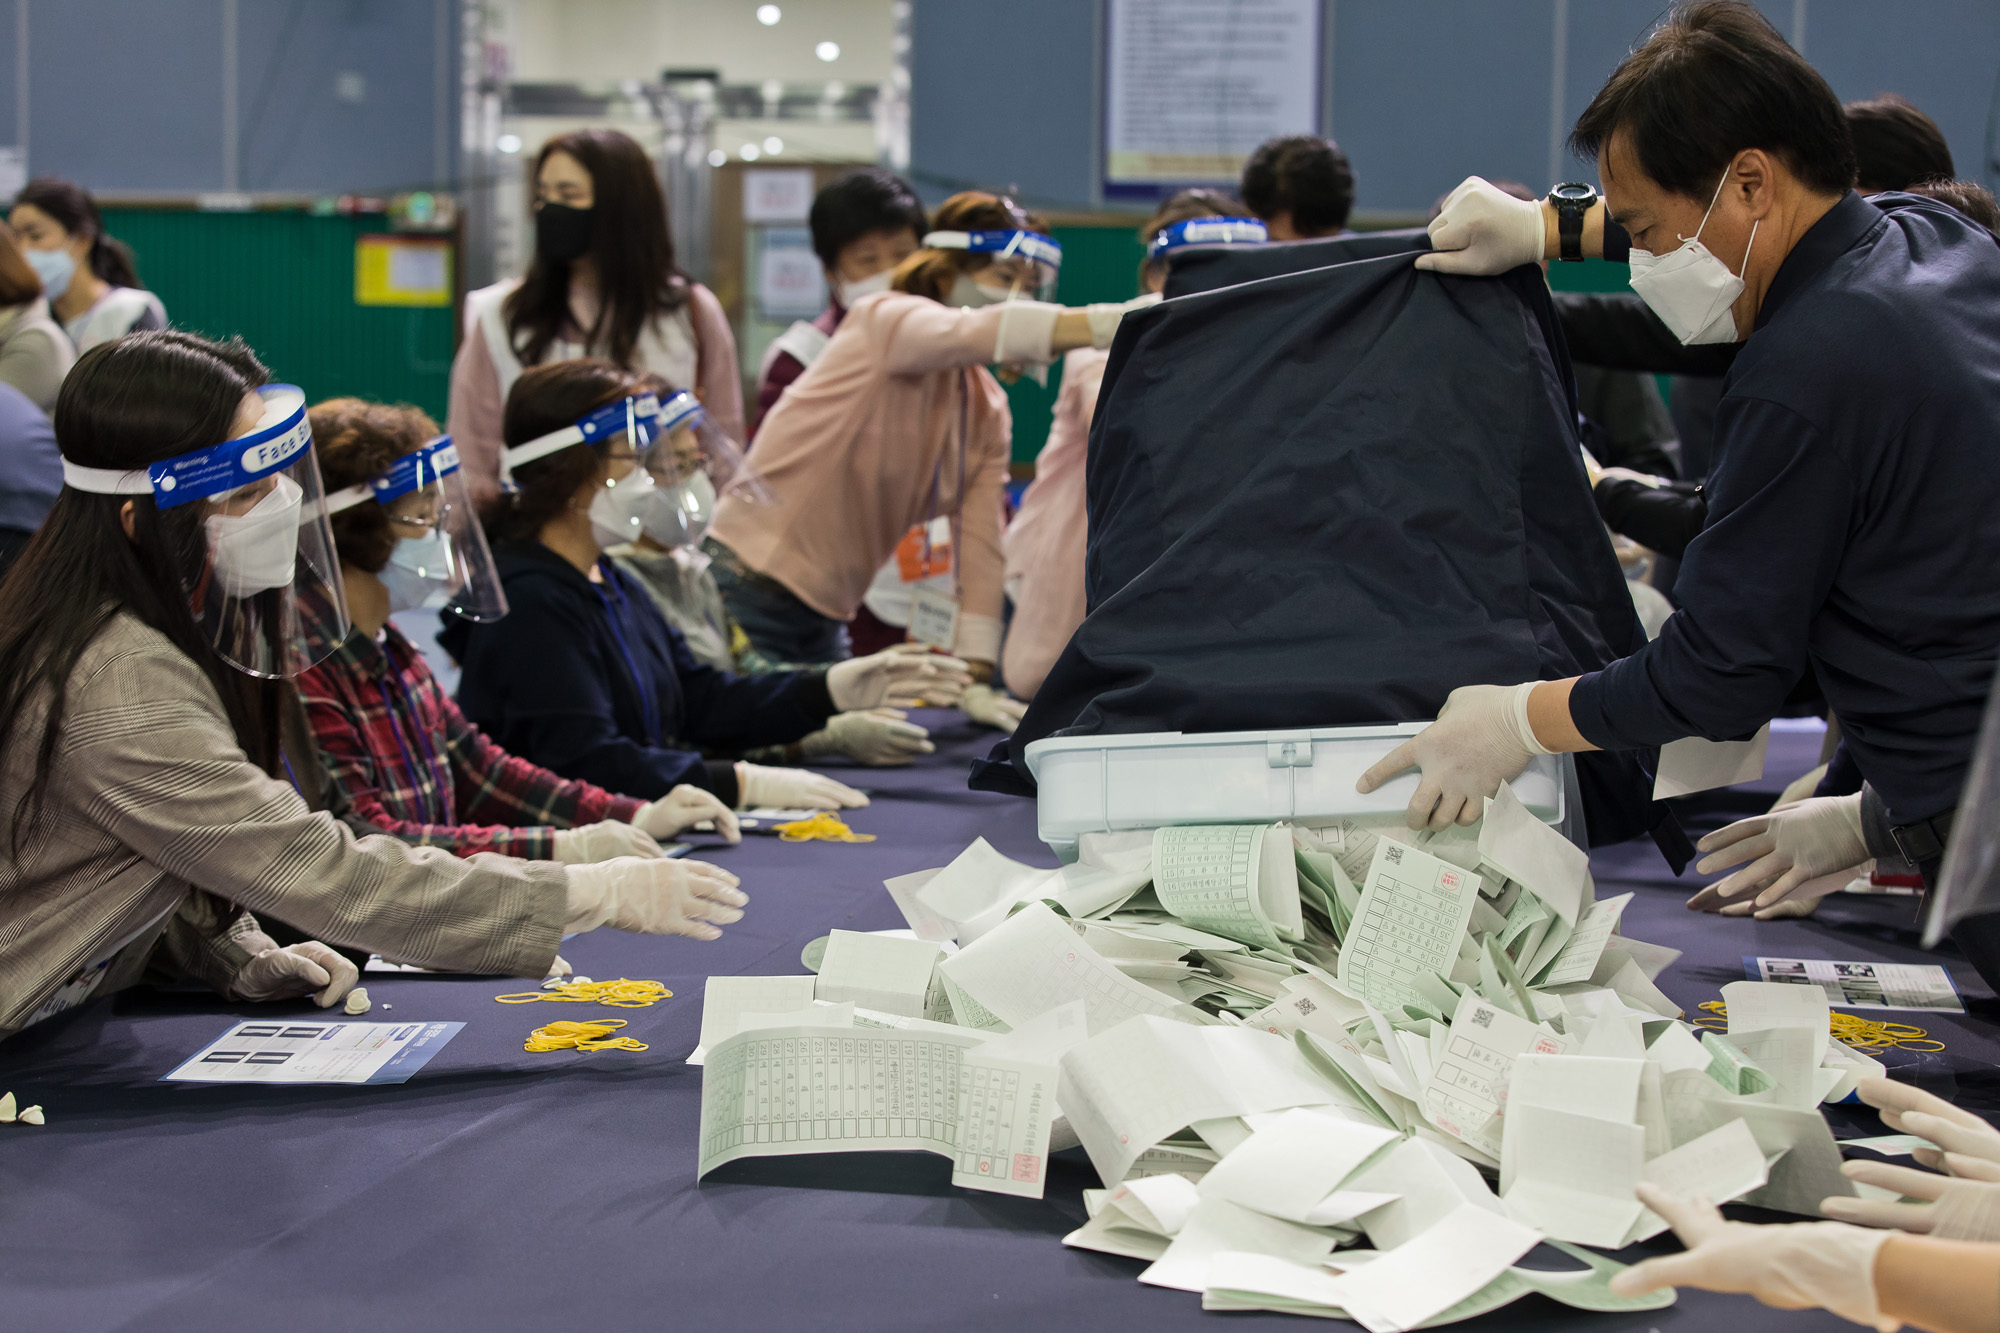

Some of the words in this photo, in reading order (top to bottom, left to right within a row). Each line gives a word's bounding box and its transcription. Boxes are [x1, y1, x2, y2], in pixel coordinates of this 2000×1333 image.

[258, 437, 296, 465] Face
[1166, 857, 1175, 865] 14
[1166, 870, 1175, 878] 15
[1168, 882, 1176, 890] 16
[1391, 896, 1440, 921] 한국복지당
[1449, 906, 1458, 915] 37
[1387, 908, 1436, 935] 통일민주당
[1444, 918, 1455, 927] 36
[1382, 921, 1431, 947] 충청의미래당
[1440, 930, 1450, 940] 35
[1378, 933, 1426, 960] 자영업당
[1435, 943, 1445, 953] 34
[1430, 956, 1441, 966] 33
[974, 1018, 984, 1026] 30
[748, 1045, 754, 1057] 30
[760, 1044, 767, 1055] 29
[773, 1043, 780, 1054] 28
[787, 1042, 794, 1053] 27
[800, 1041, 807, 1053] 26
[814, 1041, 822, 1052] 25
[830, 1042, 837, 1052] 24
[845, 1042, 852, 1053] 23
[860, 1043, 868, 1053] 22
[875, 1043, 883, 1054] 21
[890, 1044, 898, 1055] 20
[905, 1045, 913, 1055] 19
[920, 1046, 927, 1056] 18
[934, 1047, 942, 1058] 17
[947, 1049, 955, 1060] 16
[746, 1063, 755, 1123] 우리당
[760, 1061, 769, 1122] 여성의당
[773, 1061, 781, 1120] 새누리당
[786, 1059, 795, 1119] 미래민주당
[800, 1059, 809, 1119] 미래당
[814, 1058, 824, 1118] 대한민국당
[829, 1058, 839, 1117] 대한당
[860, 1059, 869, 1117] 노동당
[934, 1063, 943, 1121] 국민새정당
